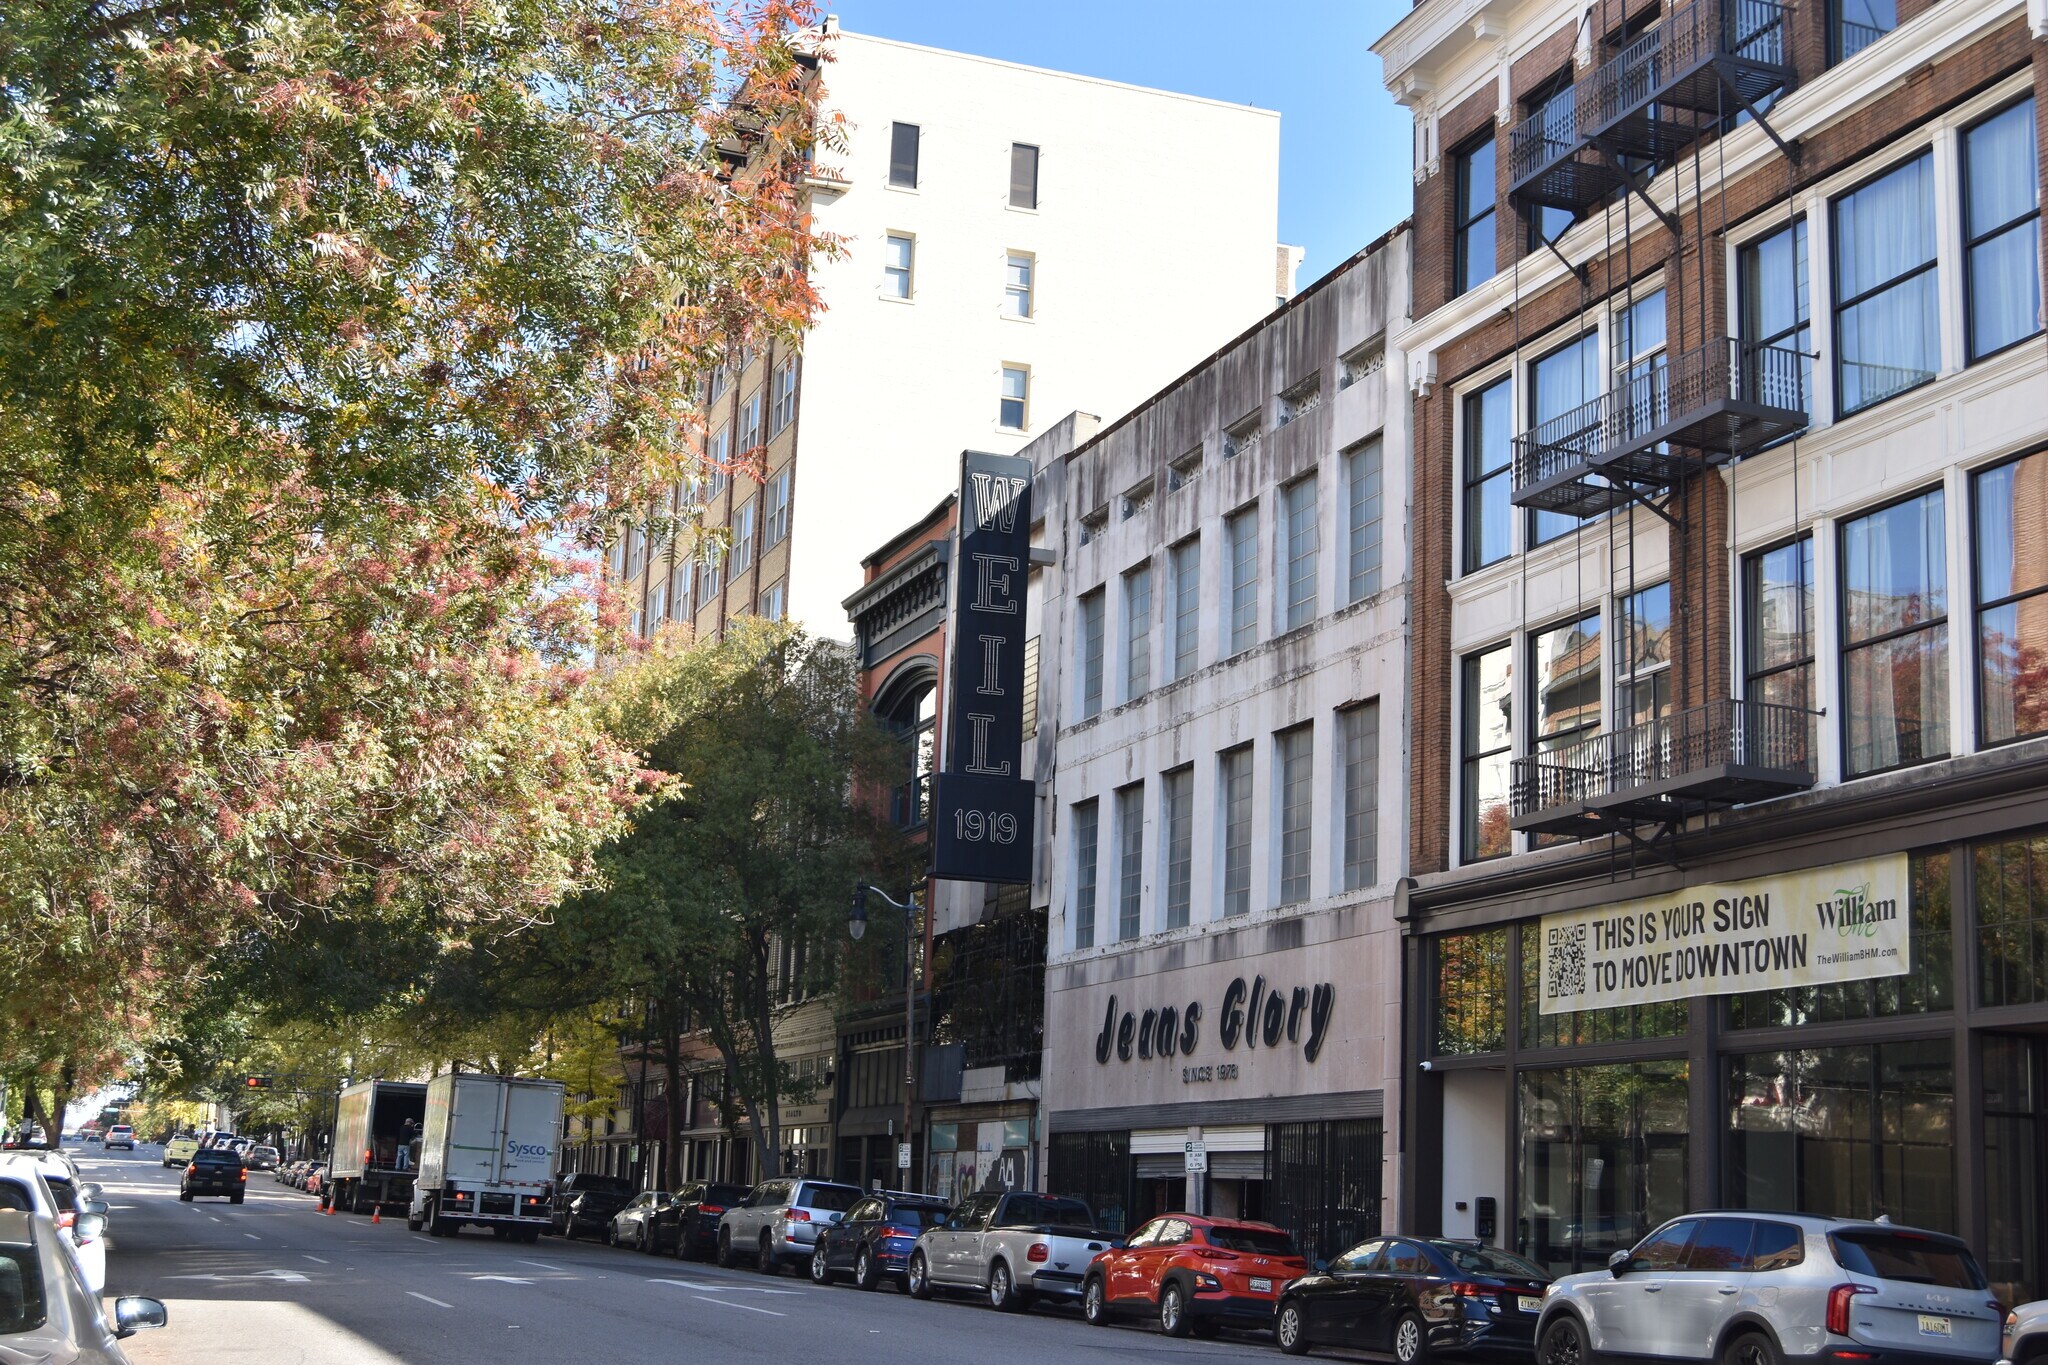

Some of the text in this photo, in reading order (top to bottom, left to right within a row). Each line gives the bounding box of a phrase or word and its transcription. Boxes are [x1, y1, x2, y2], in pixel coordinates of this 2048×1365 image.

[966, 473, 1026, 776] WEIL
[954, 808, 1018, 845] 1919
[1592, 893, 1769, 951] THIS IS YOUR SIGN
[1816, 895, 1897, 930] William
[1593, 933, 1808, 992] TO MOVE DOWNTOWN
[1816, 947, 1898, 965] TheWilliamBHM.com
[1096, 974, 1336, 1065] Jeans Glory
[1183, 1065, 1213, 1083] SINCE
[507, 1140, 546, 1157] Sysco
